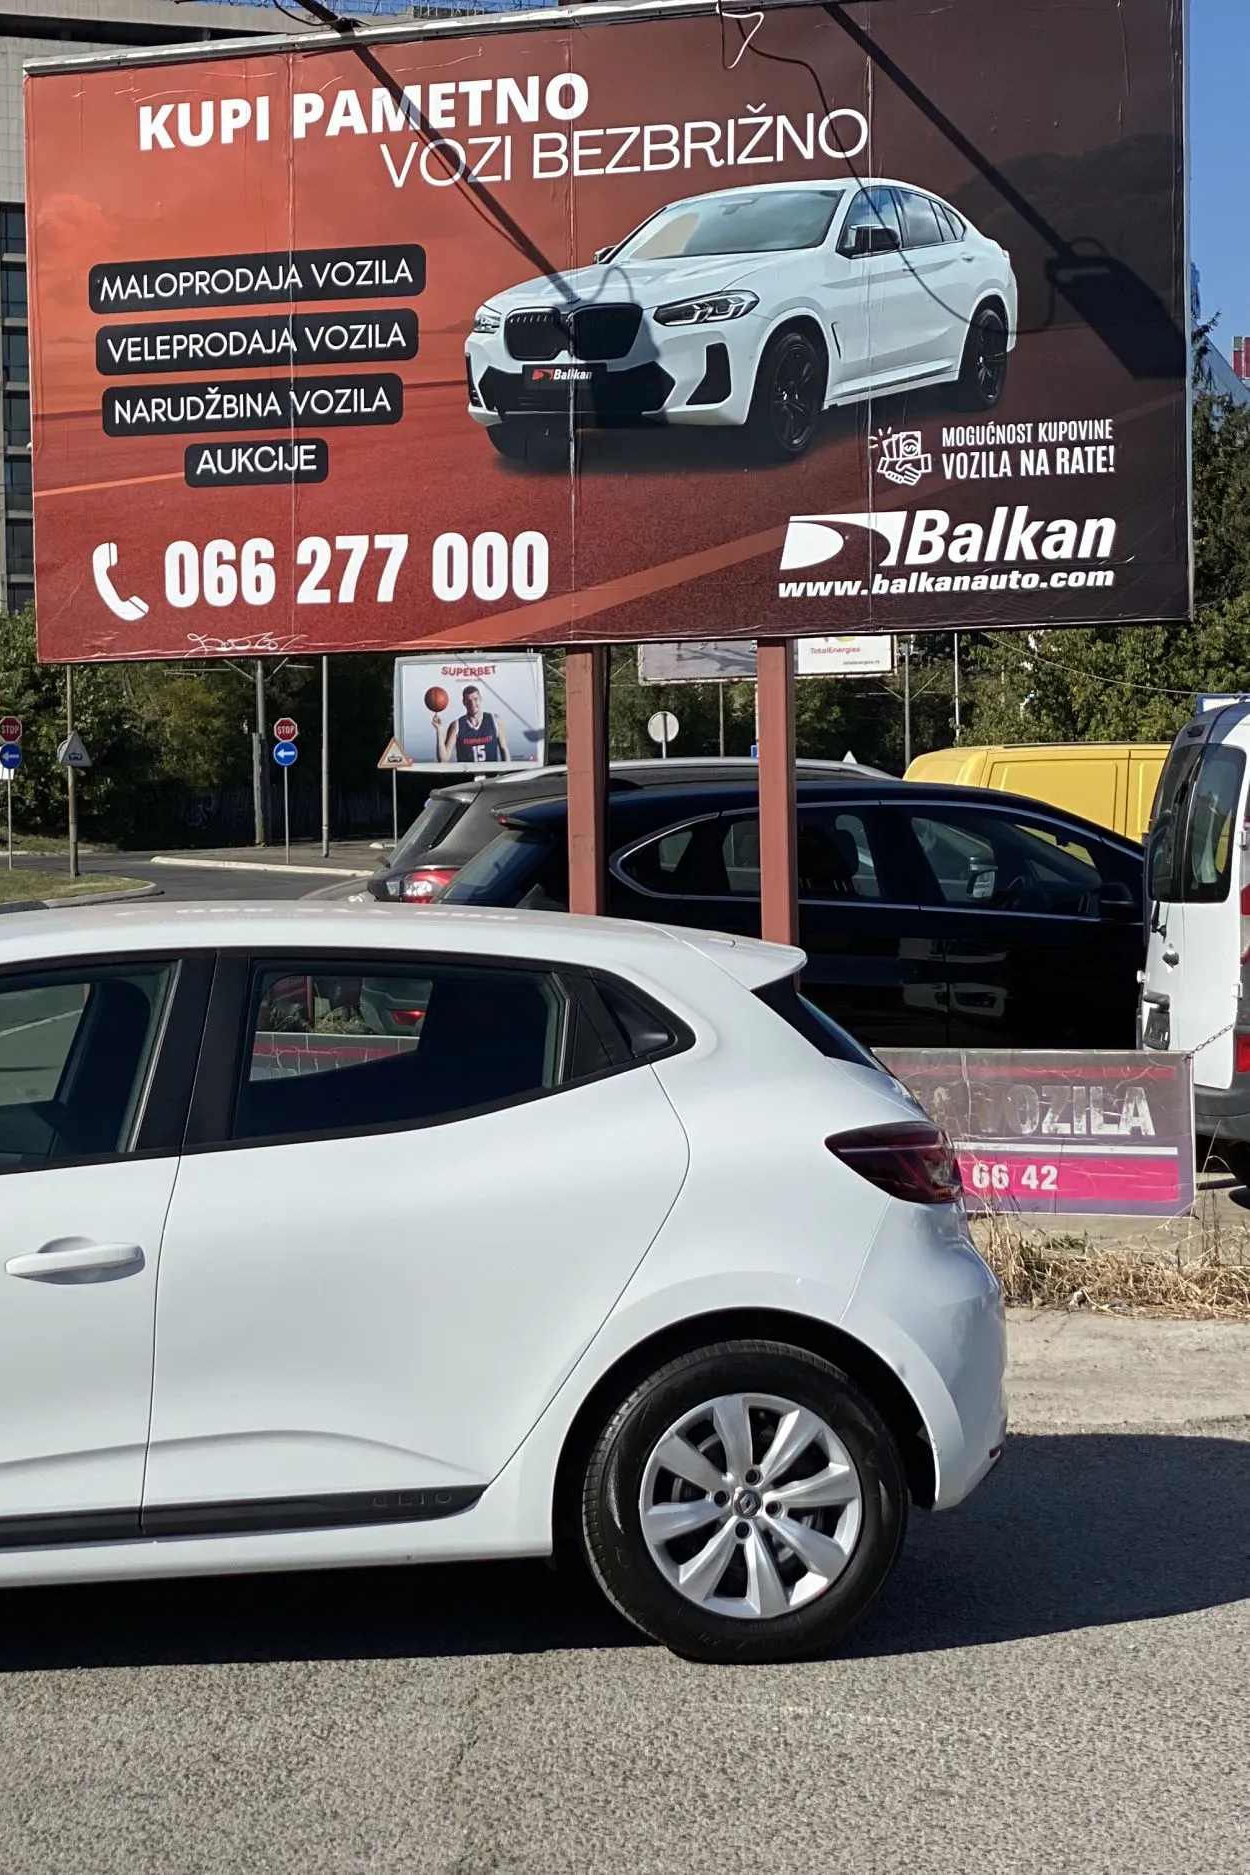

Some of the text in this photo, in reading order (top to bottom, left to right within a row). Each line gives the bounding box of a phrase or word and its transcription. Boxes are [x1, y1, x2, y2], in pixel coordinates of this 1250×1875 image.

[138, 72, 589, 152] KUPI PAMETNO
[379, 101, 868, 189] VOZI BEZBRIŽNO
[100, 257, 414, 302] MALOPRODAJA VOZILA
[107, 321, 407, 363] VELEPRODAJA VOZILA
[114, 386, 392, 425] NARUDŽBINA VOZILA
[942, 418, 1113, 447] MOGUĆNOST KUPOVINE
[196, 445, 317, 475] AUKCIJE
[942, 444, 1116, 480] VOZILA NA RATE!
[903, 505, 1117, 566] Balkan
[163, 530, 549, 610] 066 277 000
[778, 570, 1114, 598] www.balkanauto.com
[811, 647, 861, 655] TotalEnergies
[441, 665, 497, 676] SUPERBET
[0, 724, 20, 735] STOP
[277, 725, 296, 734] STOP
[472, 745, 486, 761] 15
[972, 1164, 1058, 1190] 66 42
